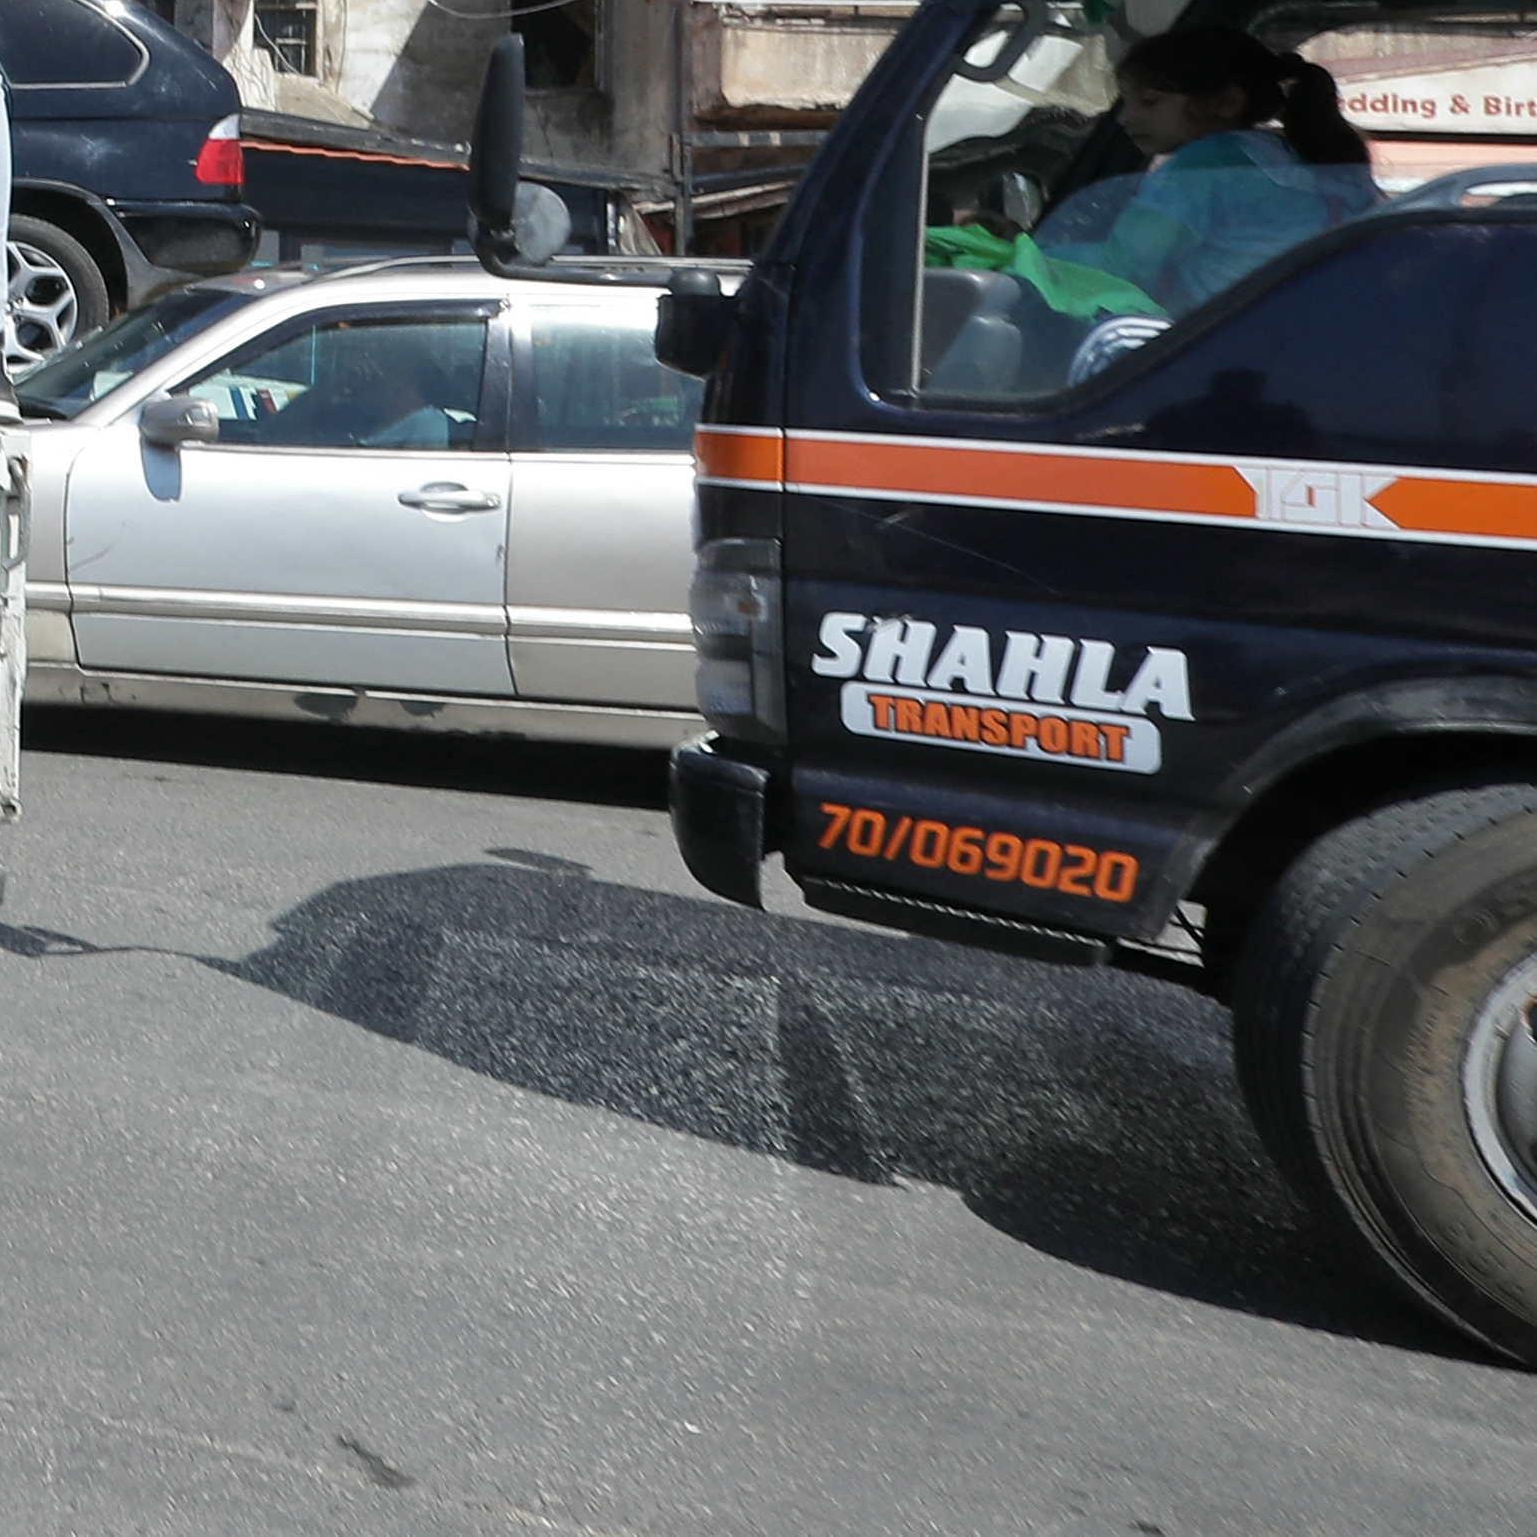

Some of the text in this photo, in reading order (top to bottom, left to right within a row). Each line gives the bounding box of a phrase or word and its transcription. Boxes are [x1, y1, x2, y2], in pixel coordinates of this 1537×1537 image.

[1449, 93, 1471, 115] &
[811, 611, 1196, 721] SHAHLA
[868, 694, 1130, 762] TRANSPORT
[818, 801, 1140, 903] 70/069020
